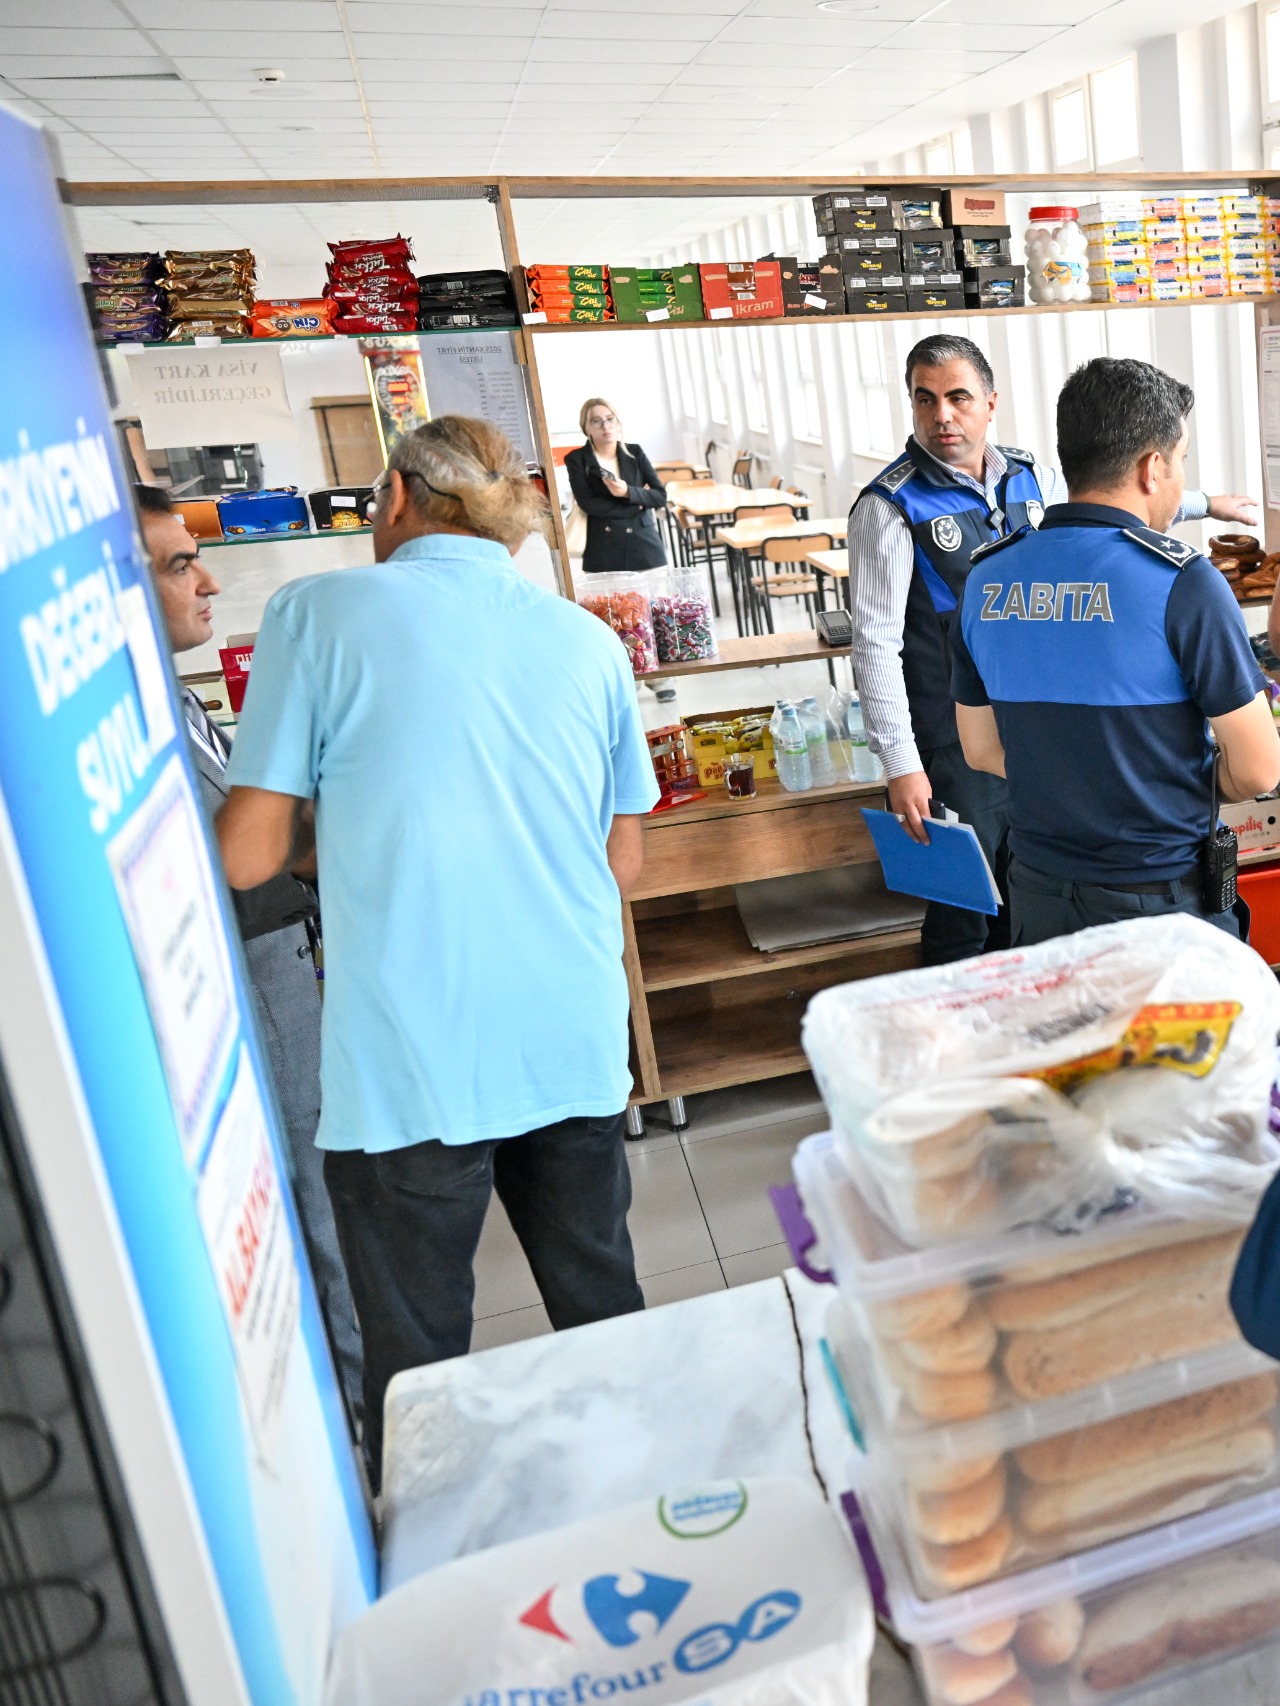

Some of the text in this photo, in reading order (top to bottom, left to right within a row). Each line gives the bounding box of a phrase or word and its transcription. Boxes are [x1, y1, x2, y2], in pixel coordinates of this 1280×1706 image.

[735, 300, 774, 315] ikram
[980, 582, 1114, 623] ZABITA
[464, 1662, 668, 1706] arrefour
